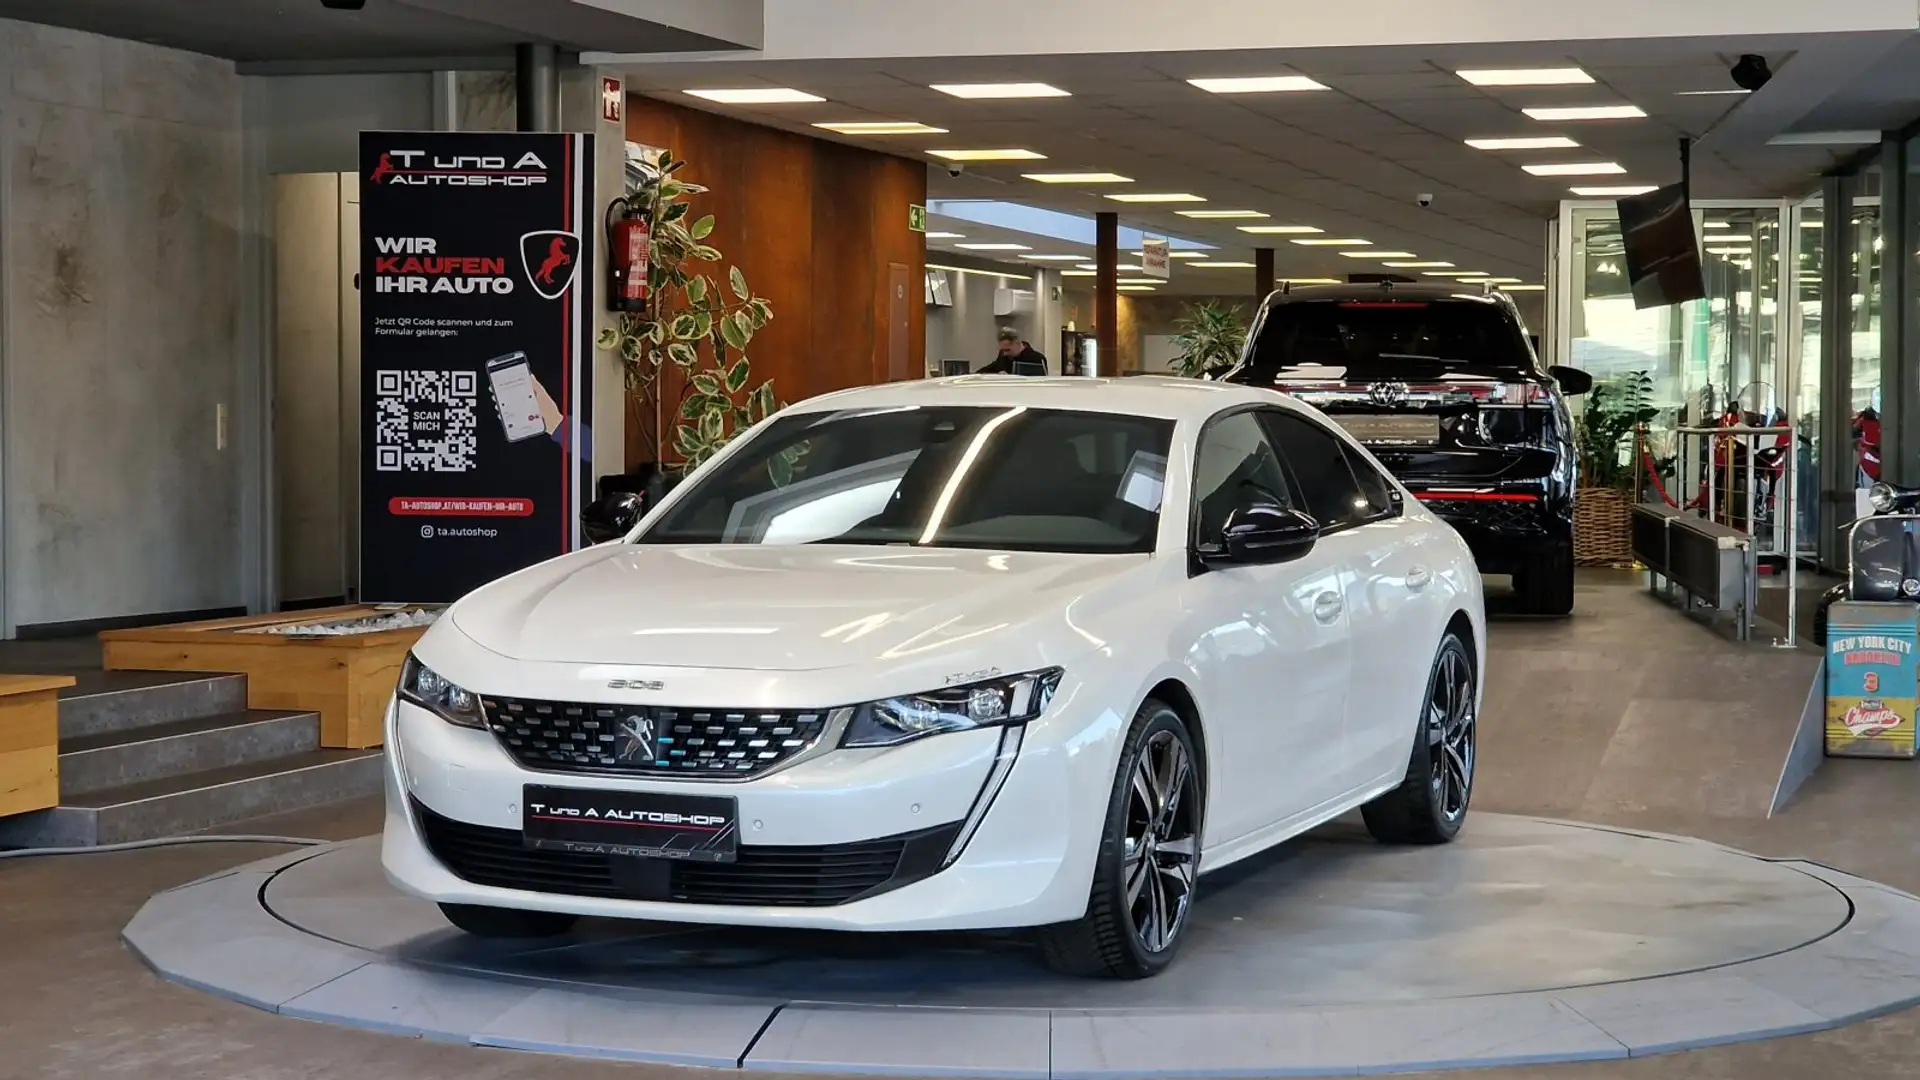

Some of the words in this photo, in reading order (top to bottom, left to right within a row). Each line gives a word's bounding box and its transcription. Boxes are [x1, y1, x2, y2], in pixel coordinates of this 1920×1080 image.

[390, 150, 425, 168] T
[512, 151, 548, 169] A
[389, 174, 548, 186] AUTOSHOP
[375, 236, 437, 254] WIR
[375, 256, 505, 275] KAUFEN
[375, 276, 429, 293] IHR
[430, 276, 514, 294] AUTO
[374, 317, 396, 327] Jetzt
[397, 317, 412, 328] QR
[412, 317, 435, 327] Code
[436, 319, 473, 327] scannen
[475, 318, 493, 327] und
[494, 319, 513, 327] zum
[375, 327, 414, 336] Formular
[415, 327, 459, 338] gelangen:
[412, 411, 441, 421] SCAN
[412, 421, 441, 431] MICH
[437, 527, 498, 538] ta.autoshop
[1832, 637, 1856, 654] NEW
[1857, 635, 1886, 649] YORK
[1887, 637, 1912, 654] CITY
[1844, 705, 1899, 728] Champs
[530, 803, 545, 813] T
[584, 808, 599, 817] A
[604, 809, 725, 825] AUTOSHOP
[563, 843, 574, 851] T
[595, 845, 605, 853] A
[609, 846, 691, 859] AUTOSHOP
